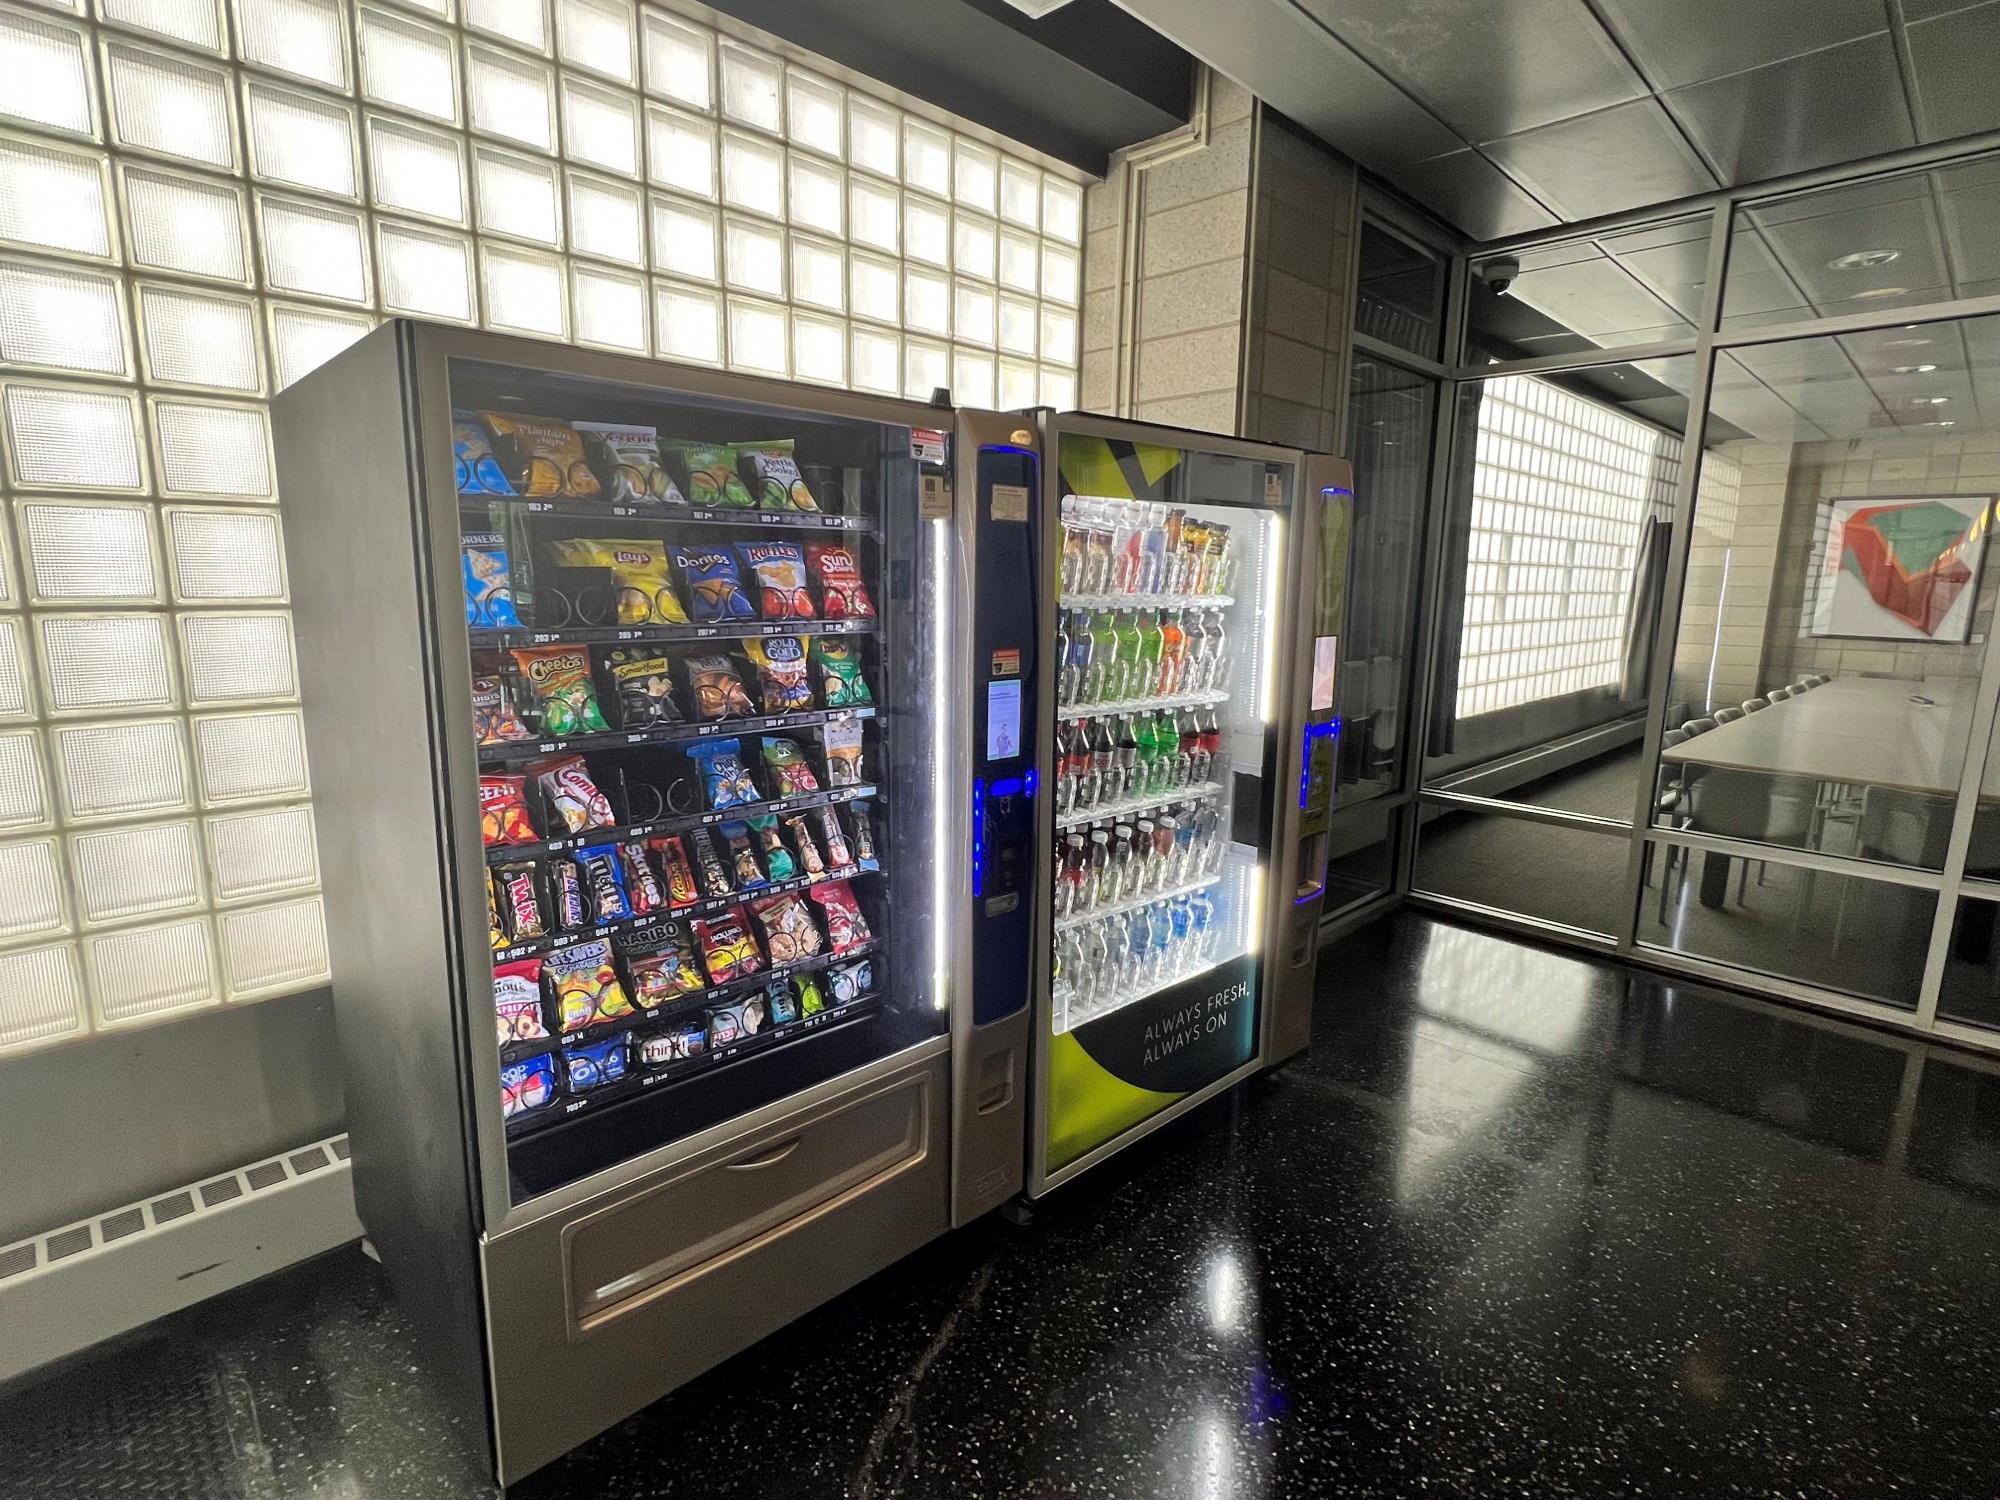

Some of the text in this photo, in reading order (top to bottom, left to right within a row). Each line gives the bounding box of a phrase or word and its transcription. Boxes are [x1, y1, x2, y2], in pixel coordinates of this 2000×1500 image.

[617, 551, 649, 565] Lay's
[676, 554, 731, 569] Doritos
[748, 546, 798, 561] RUFFLES
[767, 637, 797, 648] ROLD
[766, 648, 801, 660] GOLD
[528, 654, 584, 682] Cheetos
[618, 662, 665, 679] Smartfood
[480, 785, 516, 801] EEZ-IT
[625, 843, 661, 905] Skittles
[507, 872, 537, 928] Twix
[566, 878, 583, 927] SNICKERS
[618, 922, 678, 946] HARIBO
[570, 941, 607, 964] SAVERS
[556, 958, 607, 975] GUMMIES
[495, 979, 526, 994] nott's
[496, 1003, 537, 1015] SPBERRY
[1144, 981, 1250, 1043] ALWAYS FRESH,
[1143, 1011, 1227, 1066] ALWAYS ON
